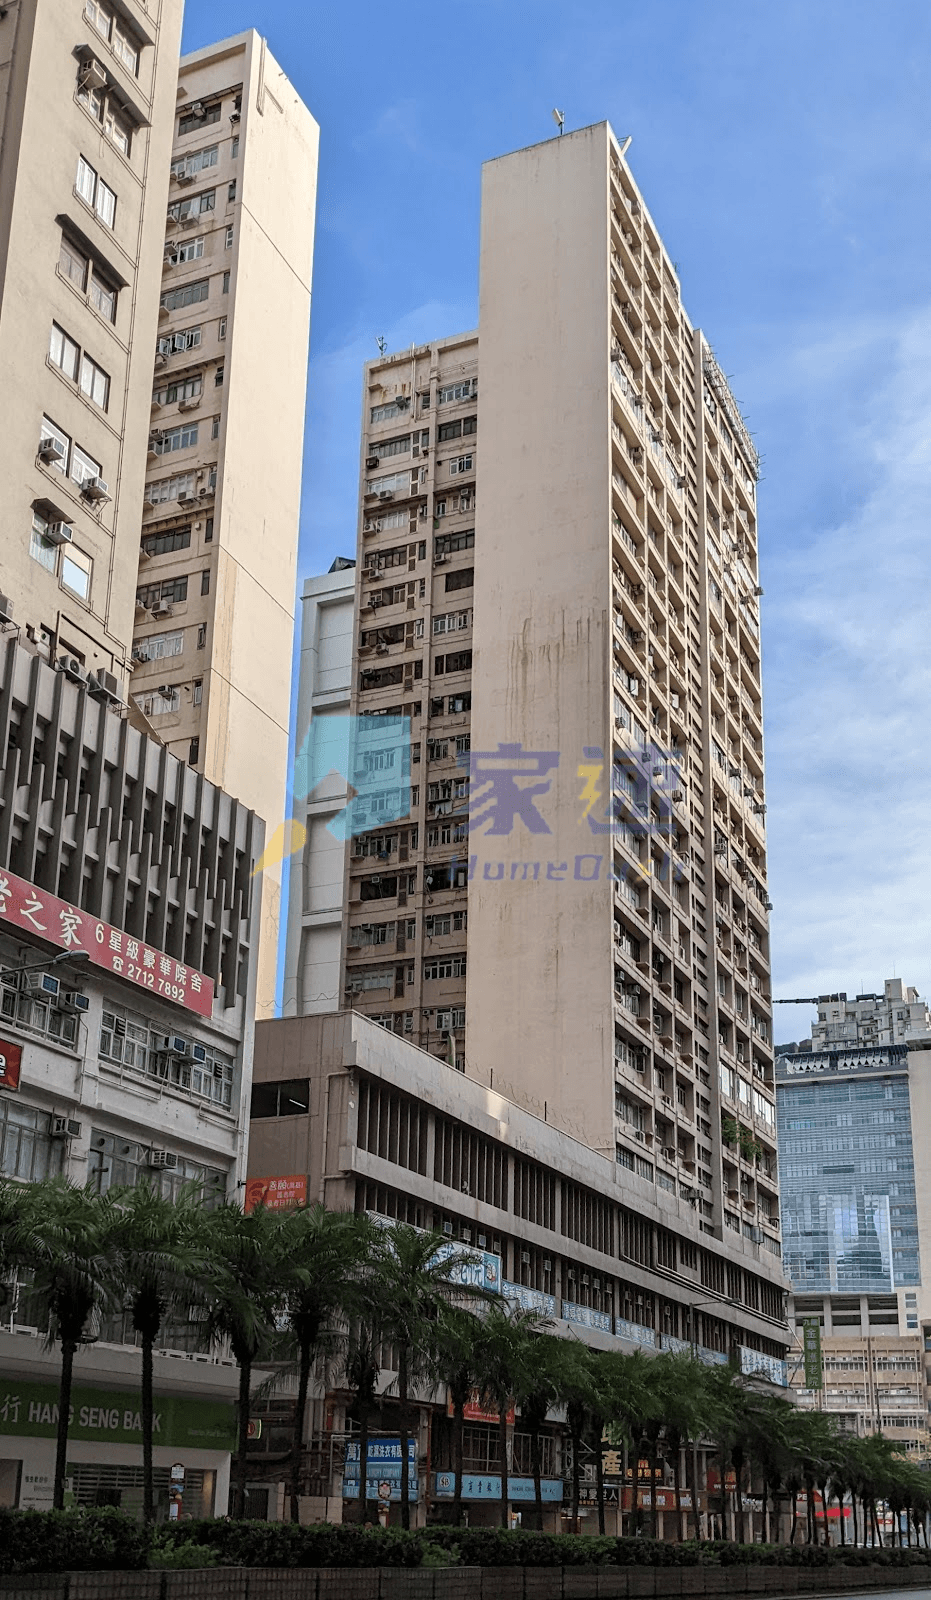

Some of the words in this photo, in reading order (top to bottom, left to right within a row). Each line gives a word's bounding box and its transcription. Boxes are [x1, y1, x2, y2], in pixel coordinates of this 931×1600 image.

[95, 923, 202, 993] 6星級豪華院舍
[127, 963, 155, 988] 2712
[158, 978, 185, 1003] 7892
[79, 1405, 120, 1430] SENG
[123, 1409, 162, 1433] BAK
